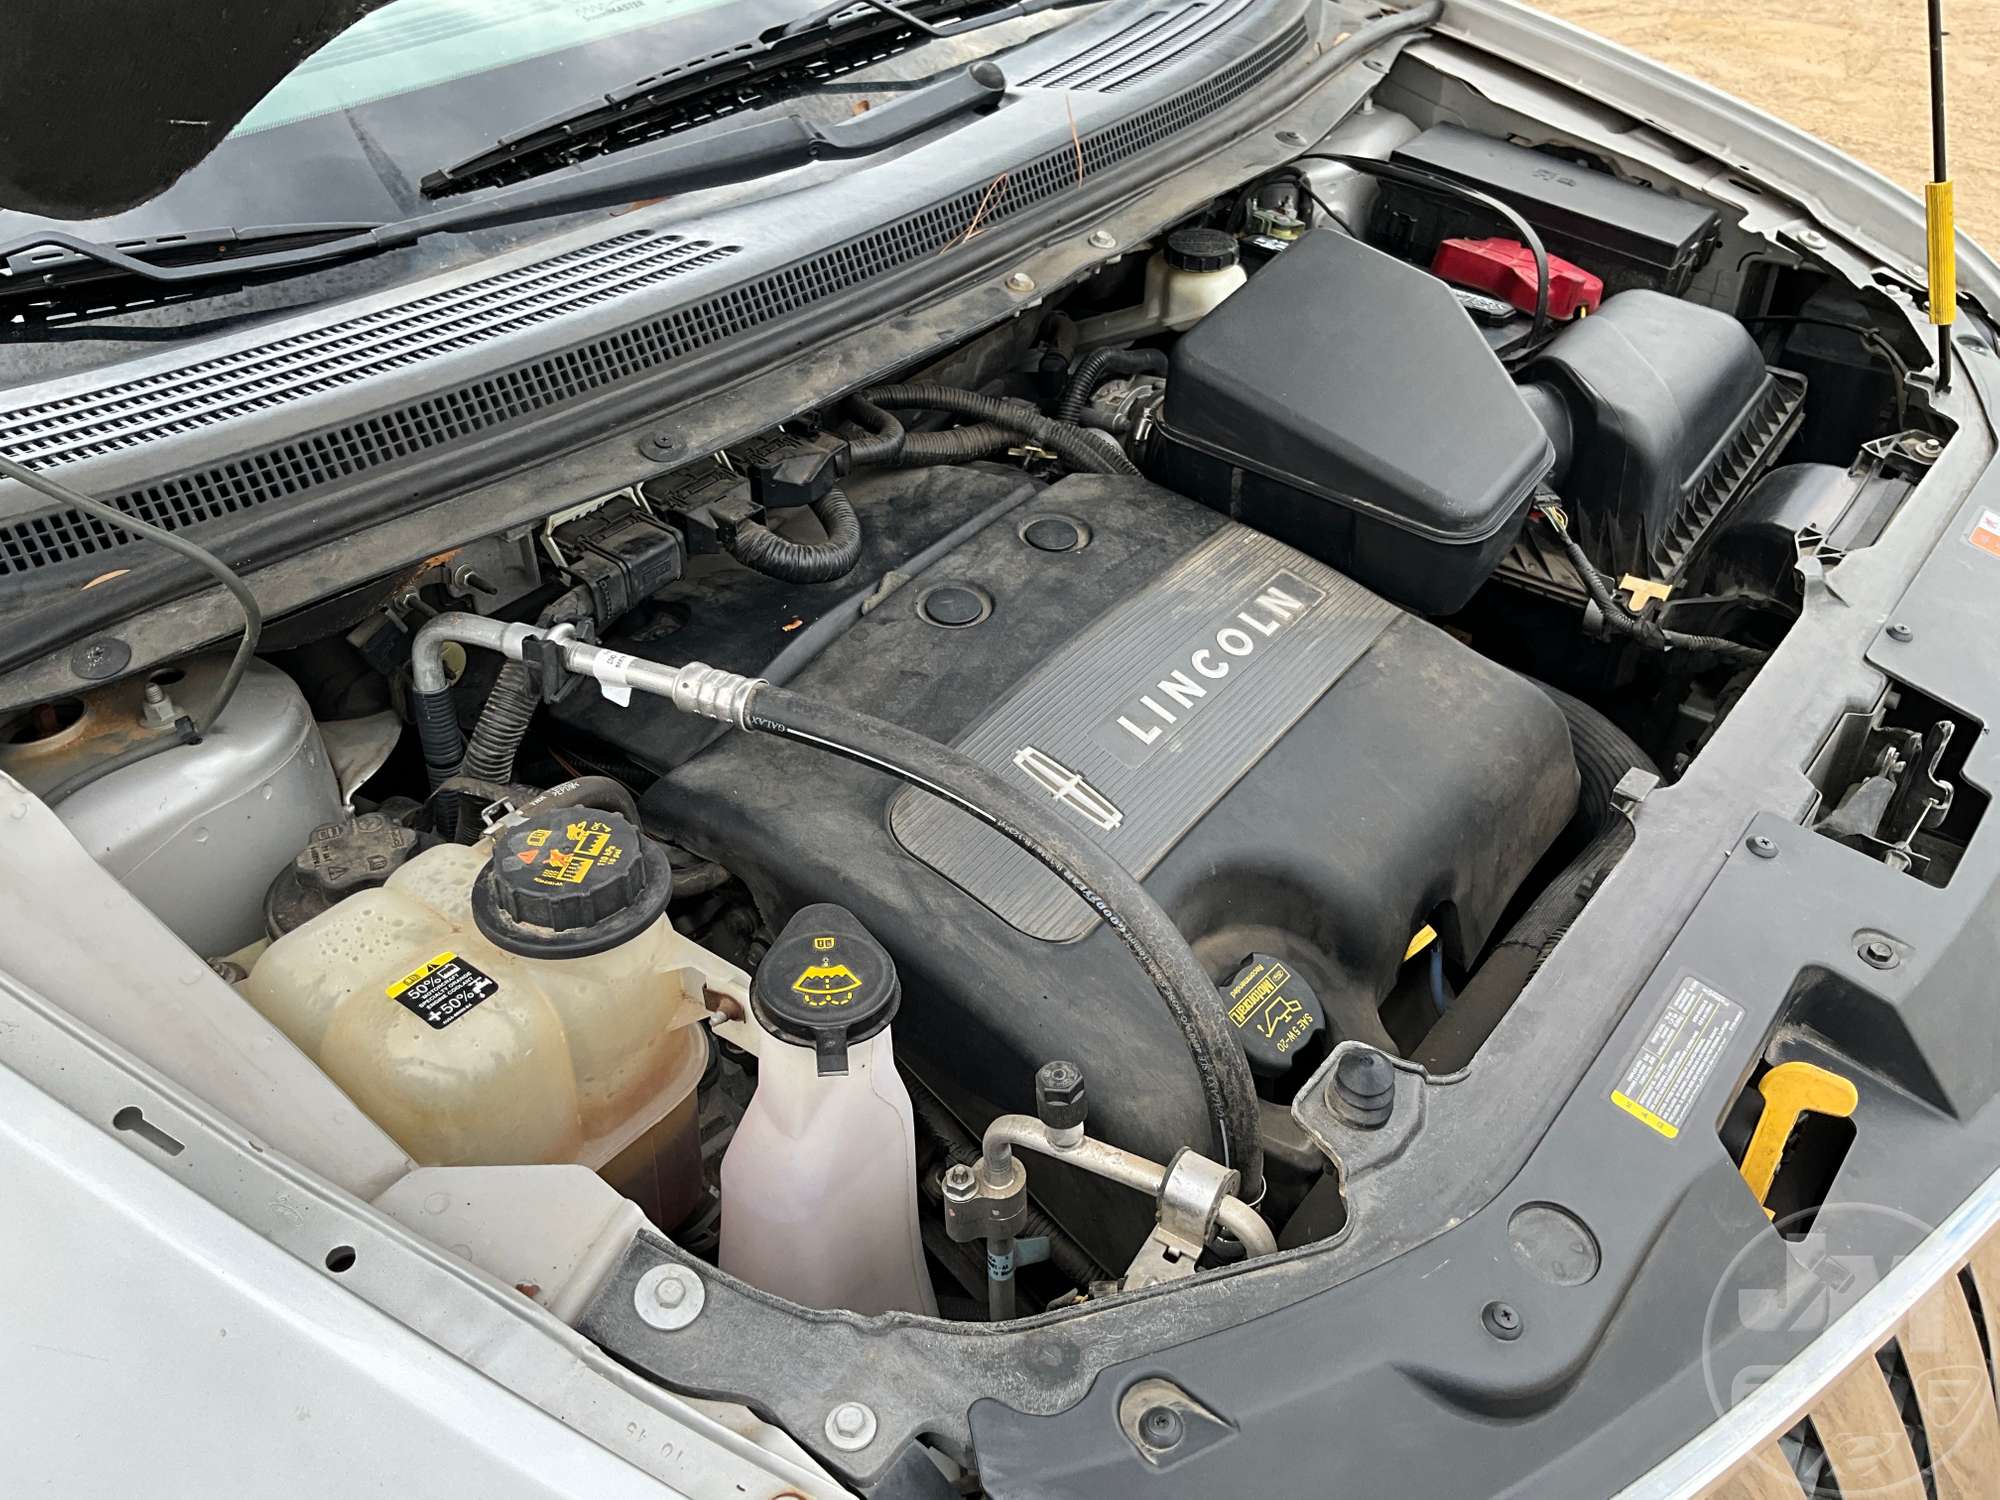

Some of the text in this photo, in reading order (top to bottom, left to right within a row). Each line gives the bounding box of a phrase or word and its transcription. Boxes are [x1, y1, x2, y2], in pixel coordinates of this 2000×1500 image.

[1116, 586, 1305, 745] LINCOLN
[1064, 871, 1126, 932] GOODYEAR
[407, 976, 442, 1000] 50%
[418, 971, 472, 1008] SPECIALTY ORANGE
[421, 973, 460, 1000] MOTORCRAFT
[426, 976, 474, 1010] ENGINE COOLANT
[1229, 963, 1264, 999] Recommended
[1231, 978, 1275, 1022] Motorcraft
[1297, 1013, 1313, 1030] SAE
